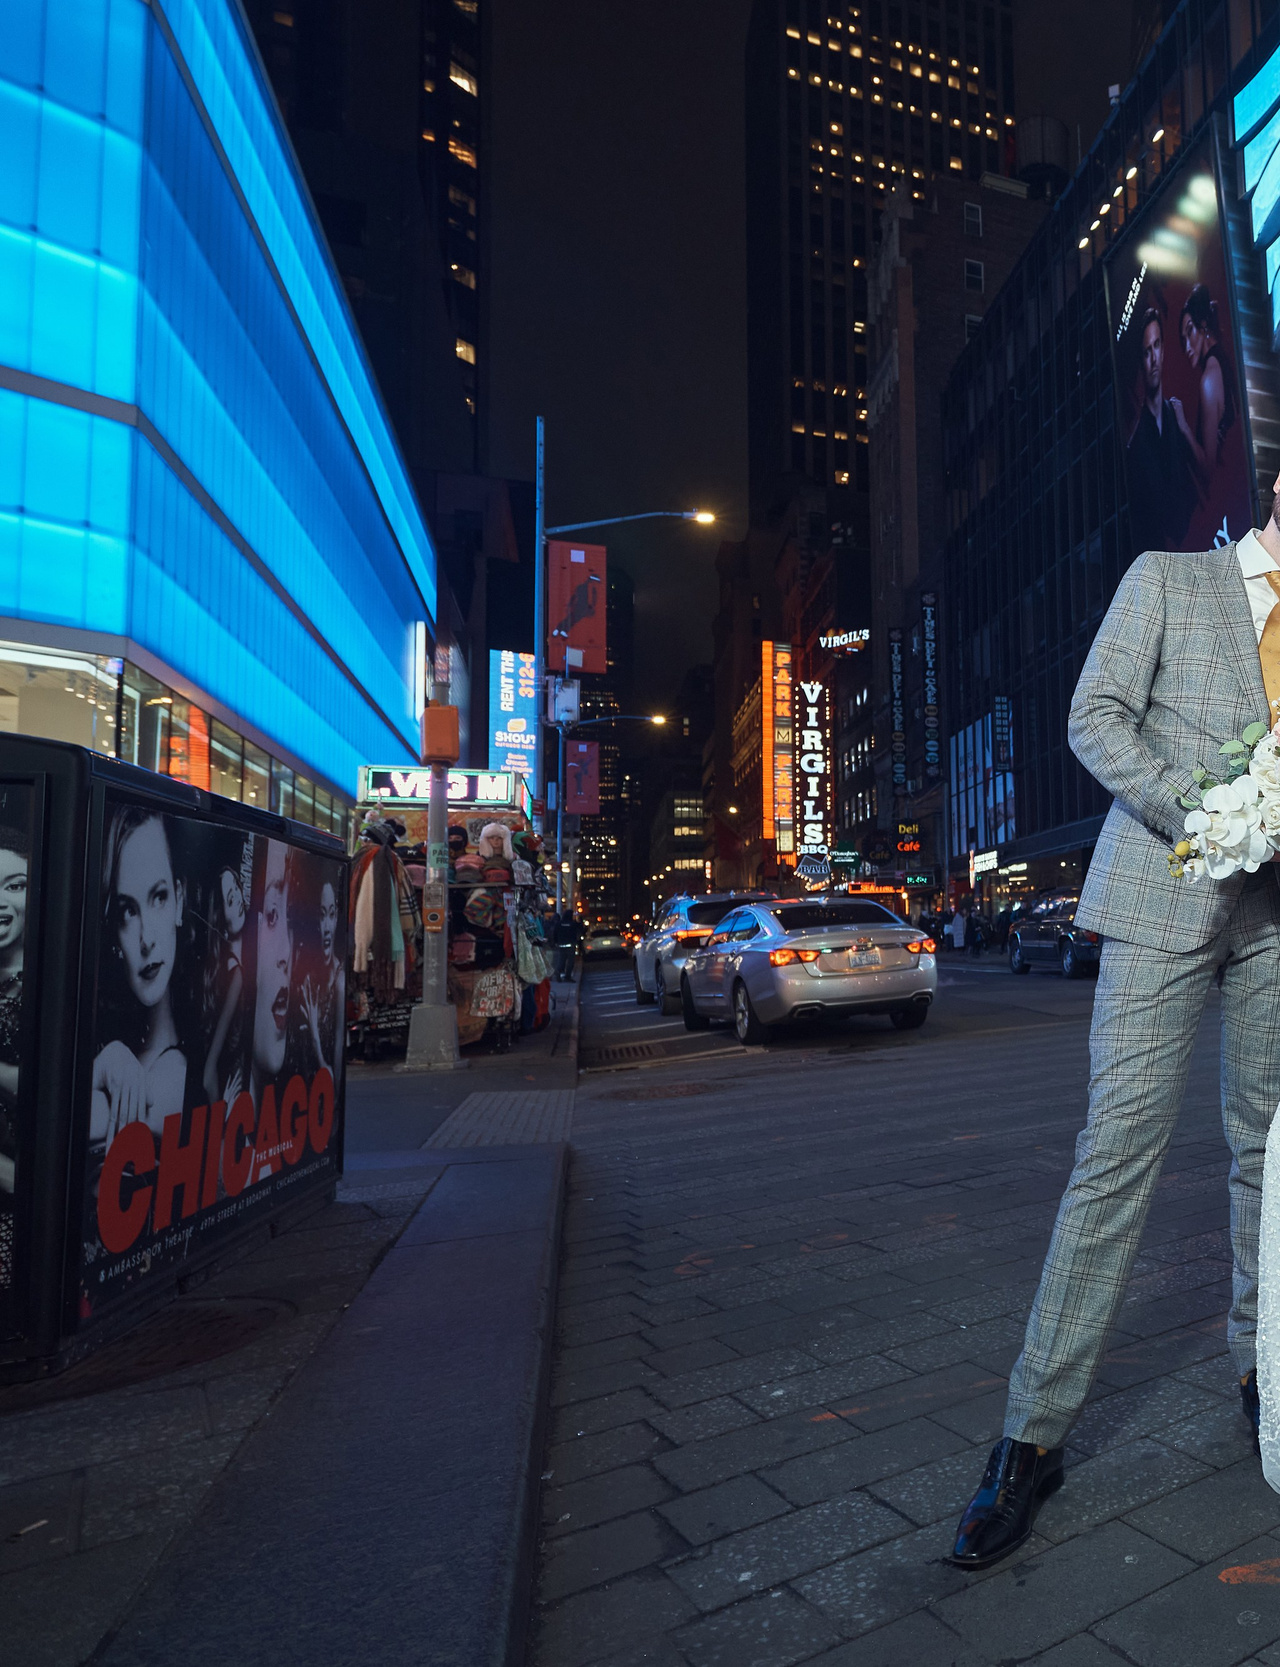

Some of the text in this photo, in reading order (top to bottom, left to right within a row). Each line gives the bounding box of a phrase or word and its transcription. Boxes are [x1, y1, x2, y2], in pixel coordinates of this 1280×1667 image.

[819, 628, 870, 648] VIRGIL'S
[500, 674, 514, 711] RENT
[776, 652, 792, 718] PARK
[776, 754, 793, 819] PARK
[898, 824, 919, 834] Deli
[800, 844, 829, 854] BBQ
[897, 841, 920, 852] Café
[801, 864, 828, 874] BAR
[97, 1067, 335, 1254] CHICAGO
[256, 1139, 293, 1164] THE MUSICAL
